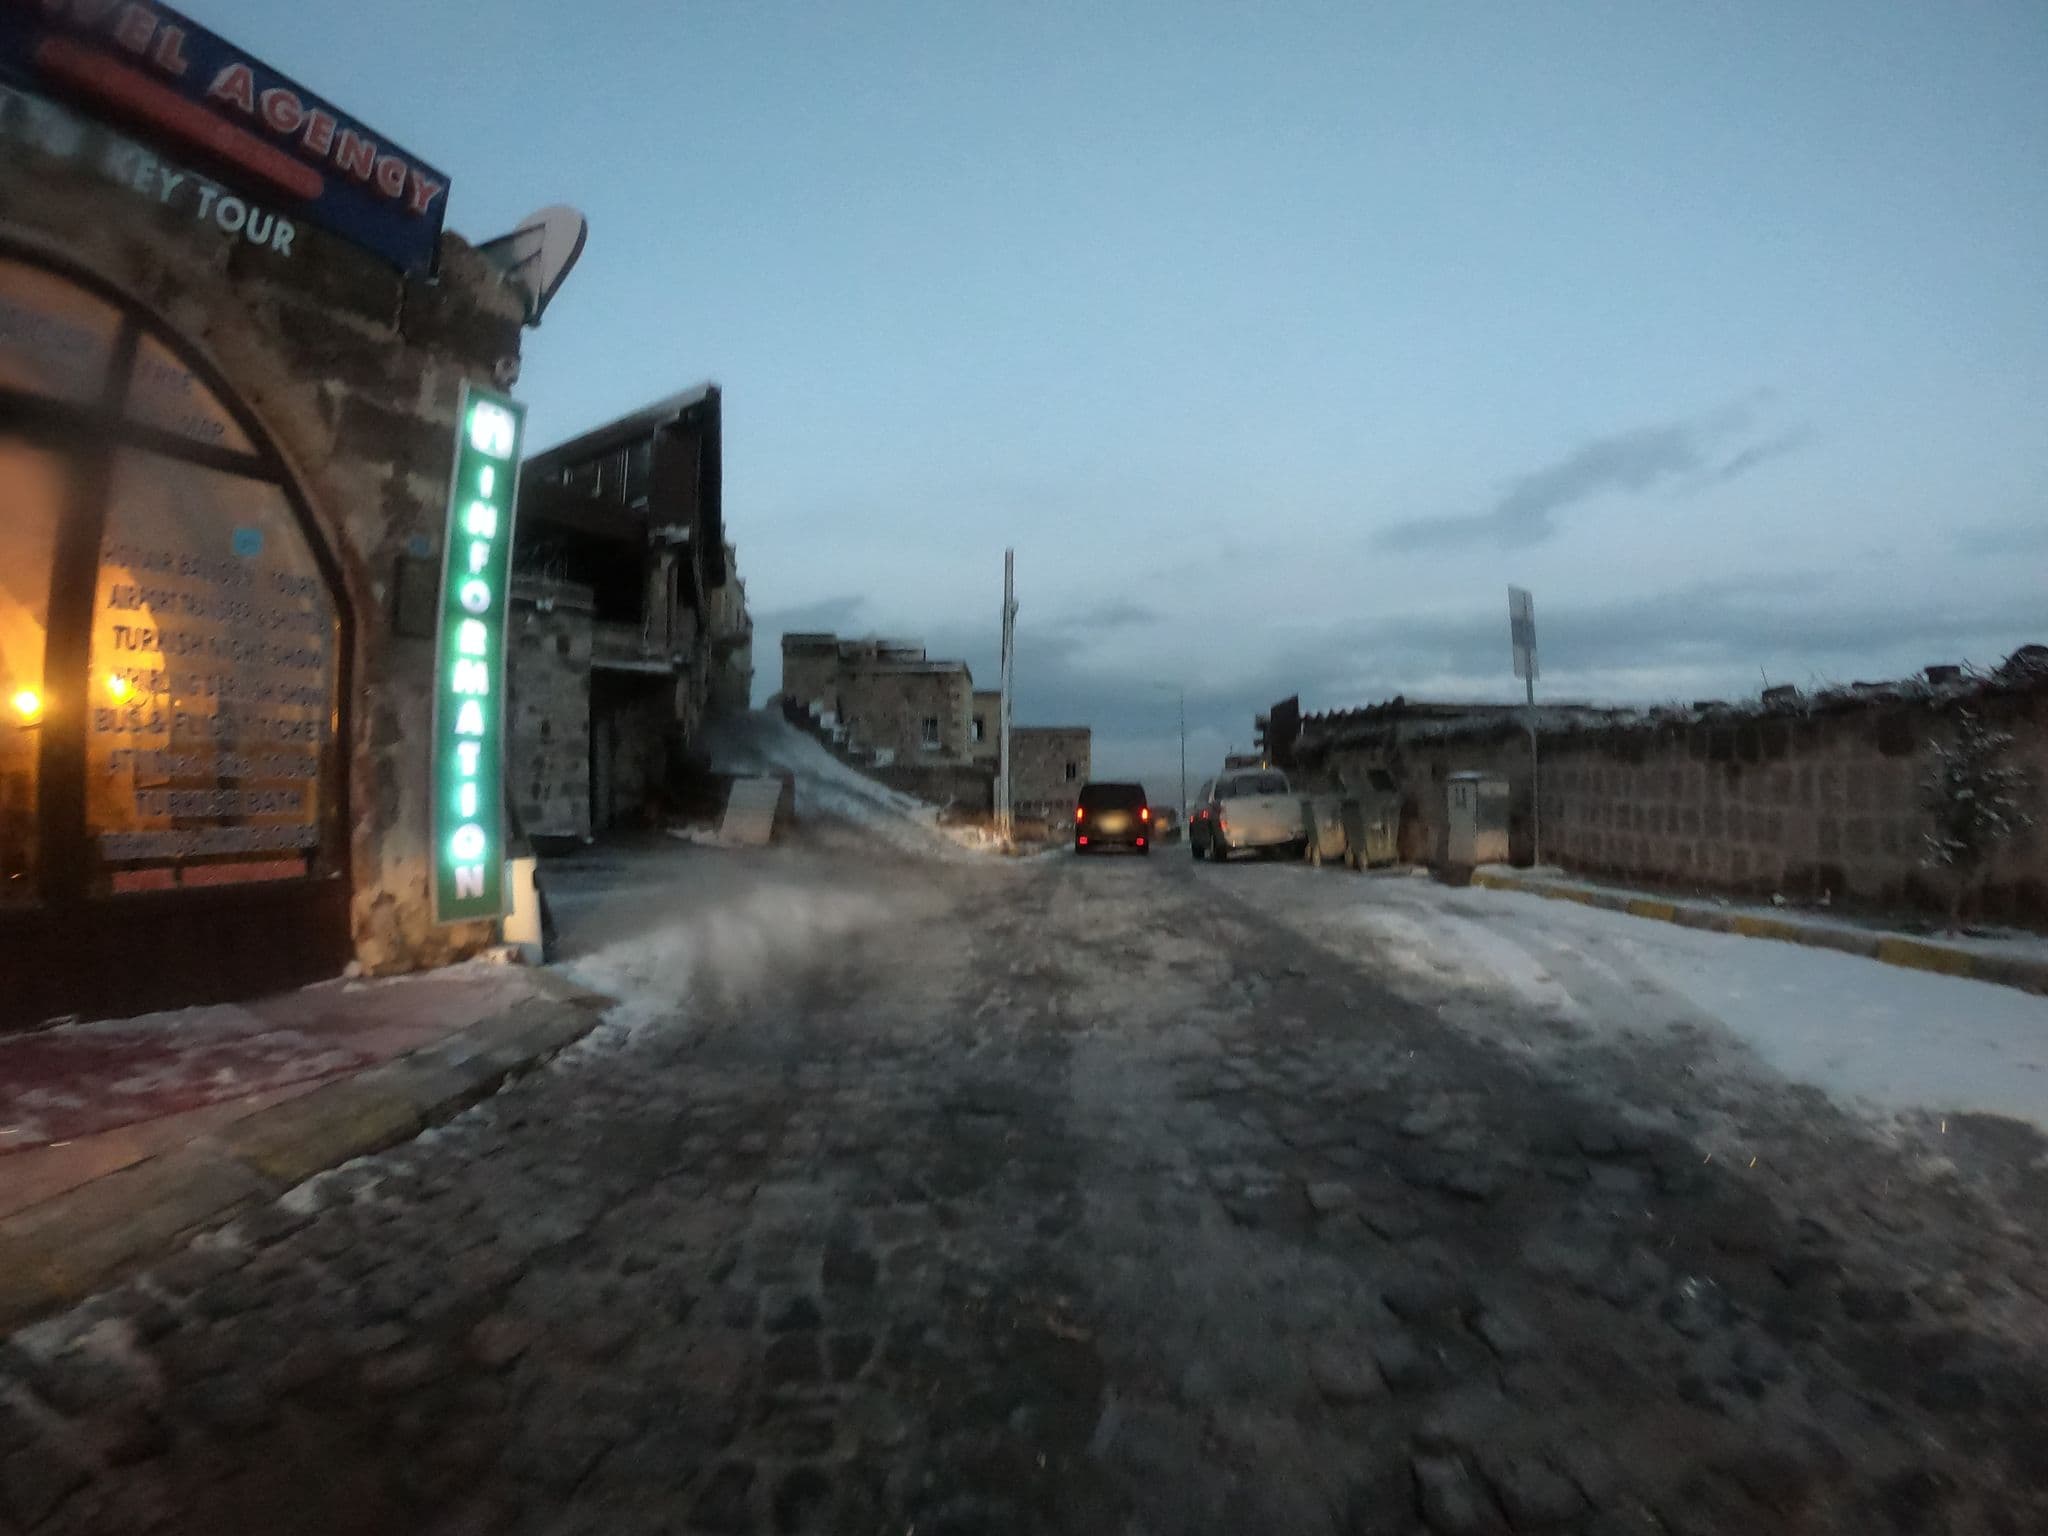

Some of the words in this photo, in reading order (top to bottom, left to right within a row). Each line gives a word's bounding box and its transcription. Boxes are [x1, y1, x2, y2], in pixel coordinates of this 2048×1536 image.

[206, 62, 441, 216] AGENCY
[198, 186, 296, 257] TOUR
[451, 465, 498, 899] INFORMATION
